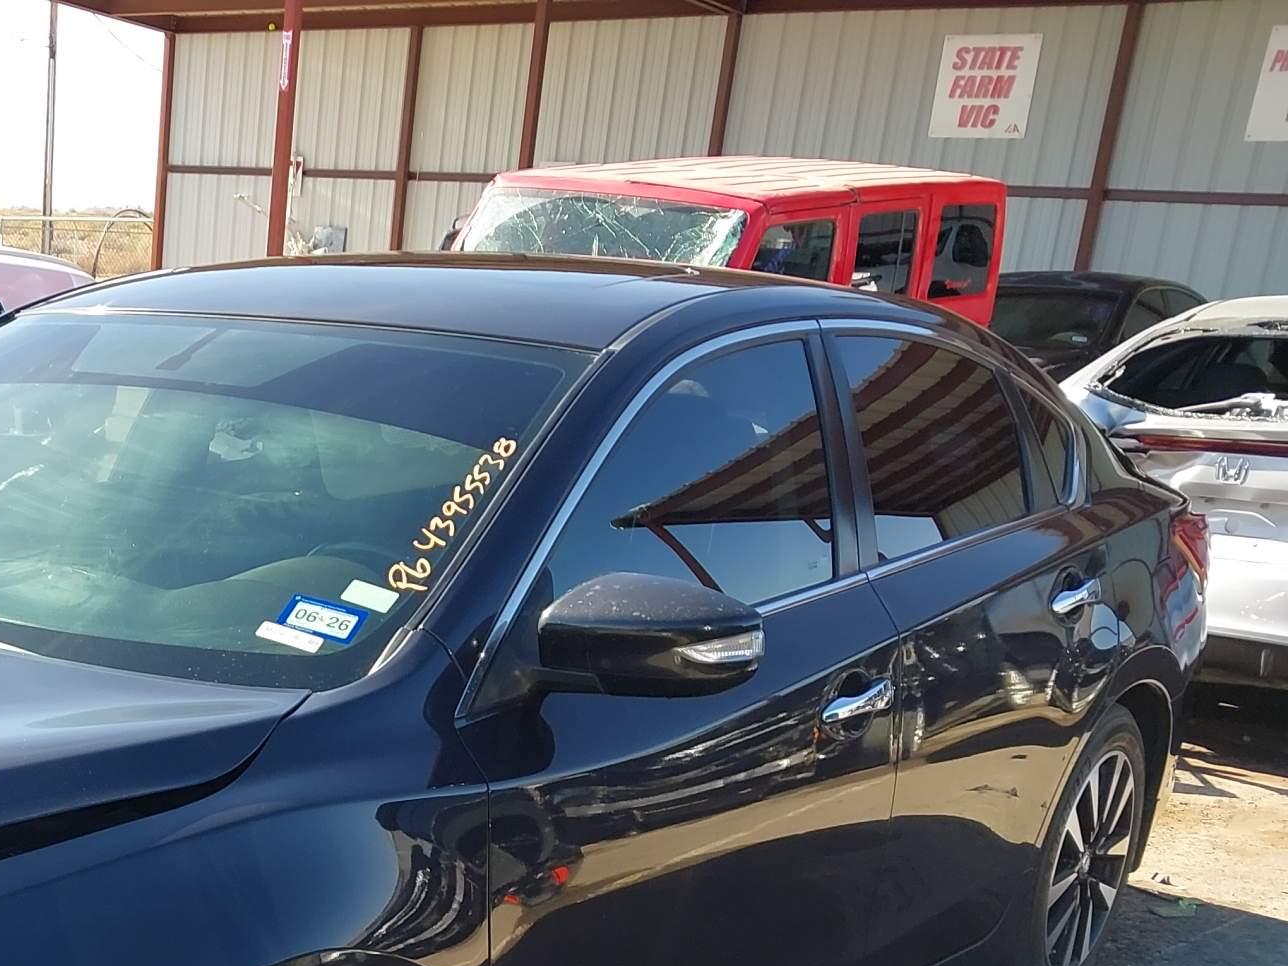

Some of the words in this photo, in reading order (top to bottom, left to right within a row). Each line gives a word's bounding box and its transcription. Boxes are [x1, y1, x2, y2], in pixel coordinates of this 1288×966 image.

[951, 46, 1025, 71] STATE
[948, 74, 1017, 100] FARM
[957, 104, 1001, 129] VIC
[412, 437, 517, 551] 43955538
